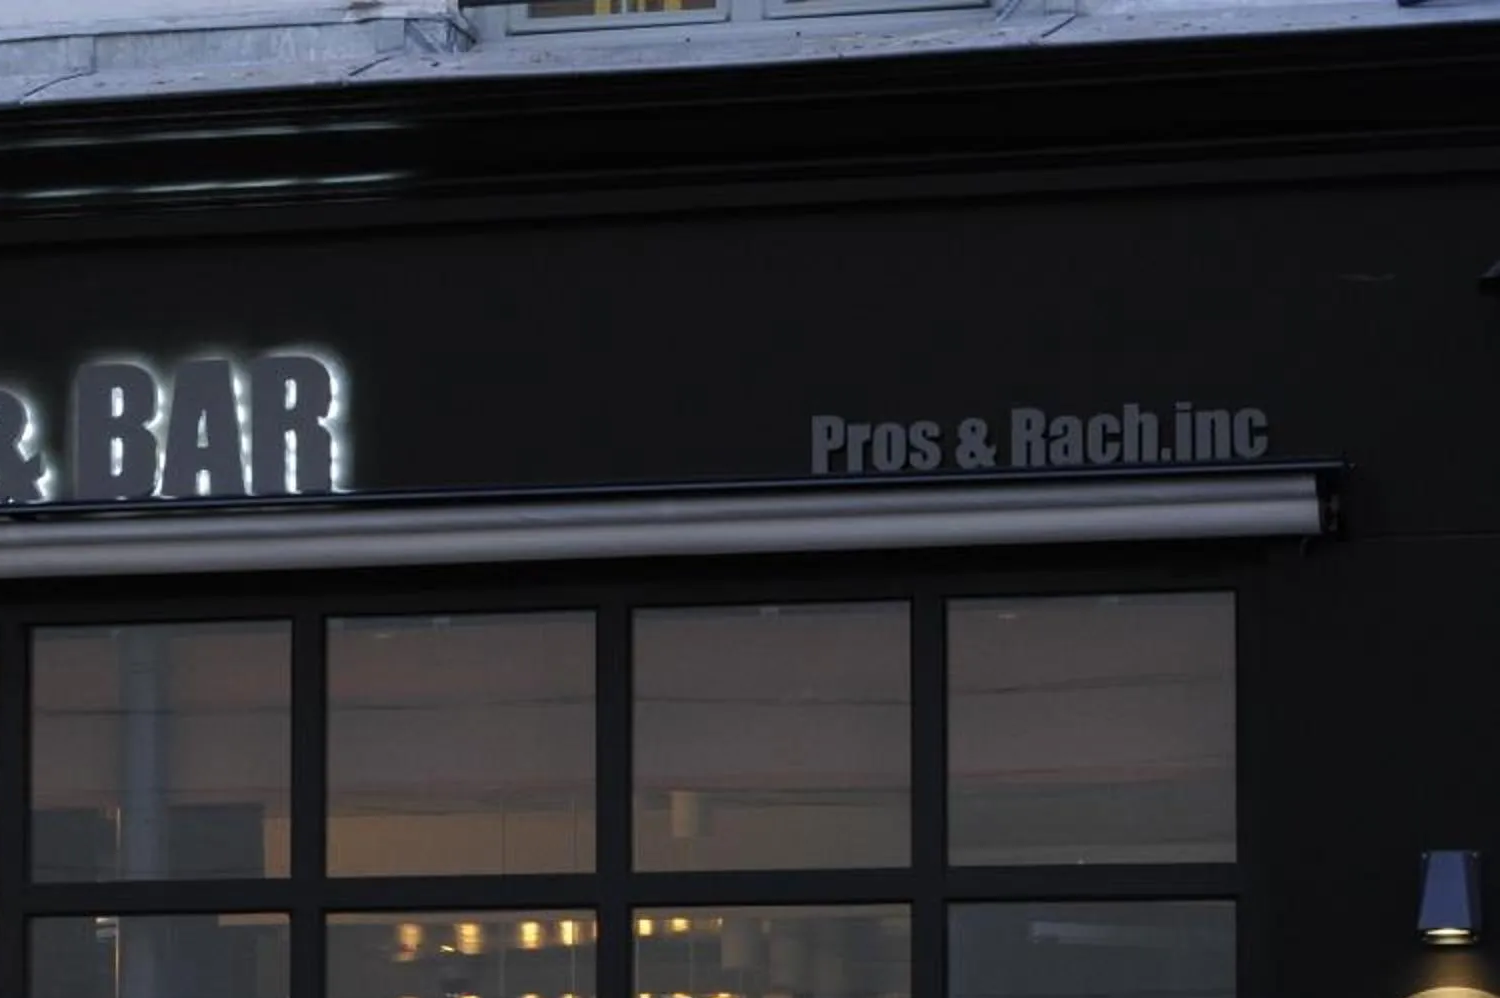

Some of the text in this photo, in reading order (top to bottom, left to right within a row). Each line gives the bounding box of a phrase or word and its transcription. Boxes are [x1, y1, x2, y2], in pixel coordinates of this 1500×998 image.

[74, 353, 338, 500] BAR
[811, 401, 1269, 475] Pros & Rach.inc
